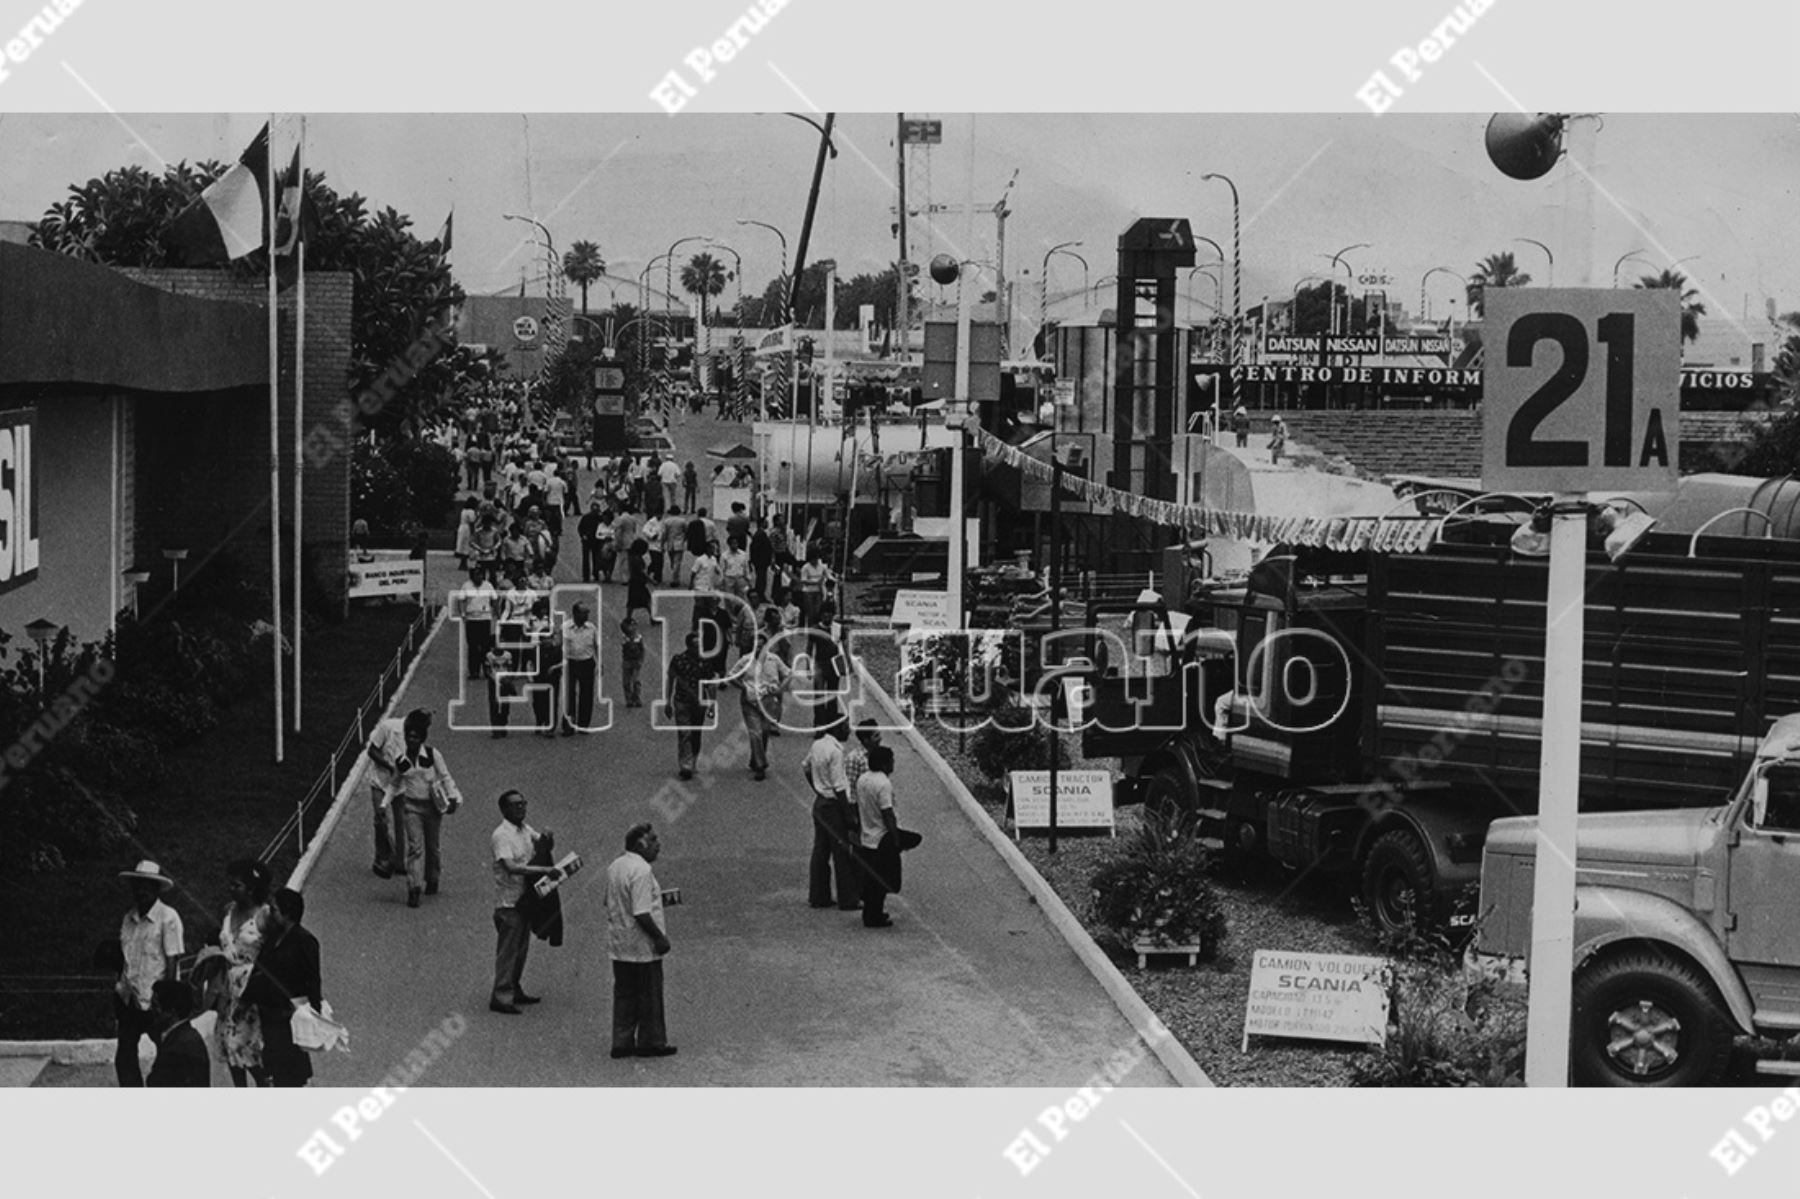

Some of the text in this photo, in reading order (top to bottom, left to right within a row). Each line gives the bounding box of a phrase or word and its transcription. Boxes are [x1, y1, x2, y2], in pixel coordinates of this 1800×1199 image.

[1268, 338, 1377, 352] DATSUN NISSAN
[1343, 368, 1372, 383] DE
[1383, 369, 1480, 385] INFORM
[905, 600, 938, 608] SCANIA
[1061, 775, 1103, 783] TRACTOR
[1450, 915, 1476, 927] SCA
[1259, 957, 1311, 971] CAMION
[1278, 975, 1362, 992] SCANIA
